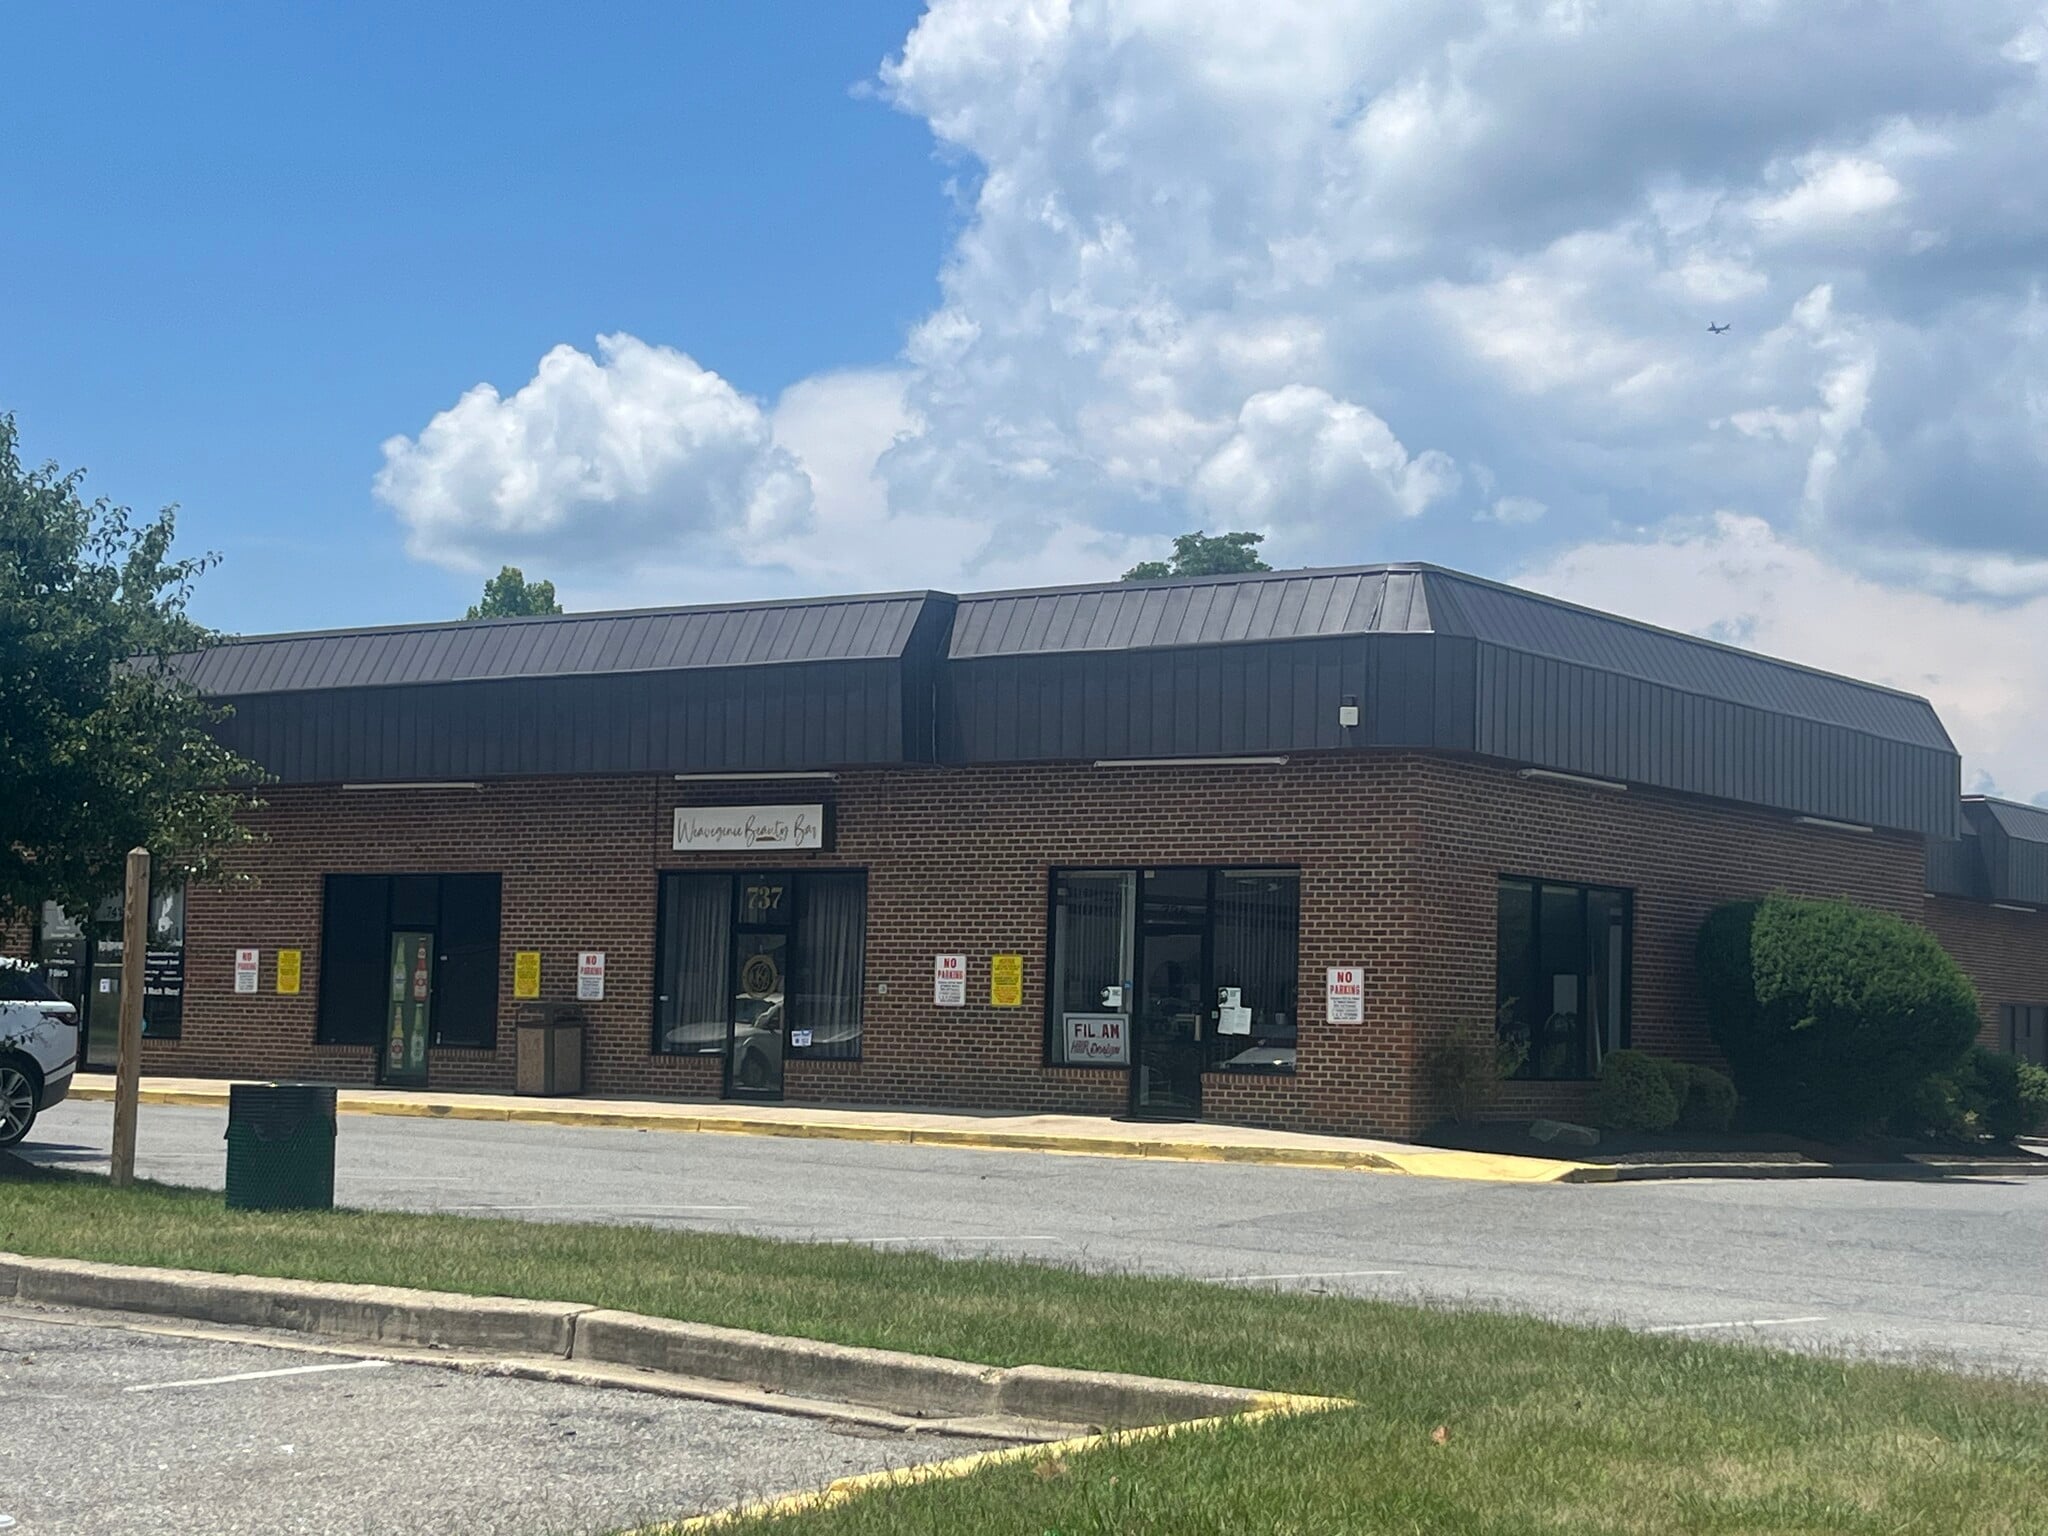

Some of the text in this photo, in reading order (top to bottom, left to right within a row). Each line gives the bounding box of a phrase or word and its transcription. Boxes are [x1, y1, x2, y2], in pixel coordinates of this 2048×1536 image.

[744, 814, 789, 848] Beauty
[793, 813, 817, 847] Bar
[747, 886, 784, 910] 737
[585, 955, 598, 966] NO
[943, 957, 957, 969] NO
[937, 970, 964, 980] PARKING
[1337, 971, 1353, 983] NO
[1329, 984, 1361, 995] PARKING
[1074, 1023, 1120, 1039] FIL AM
